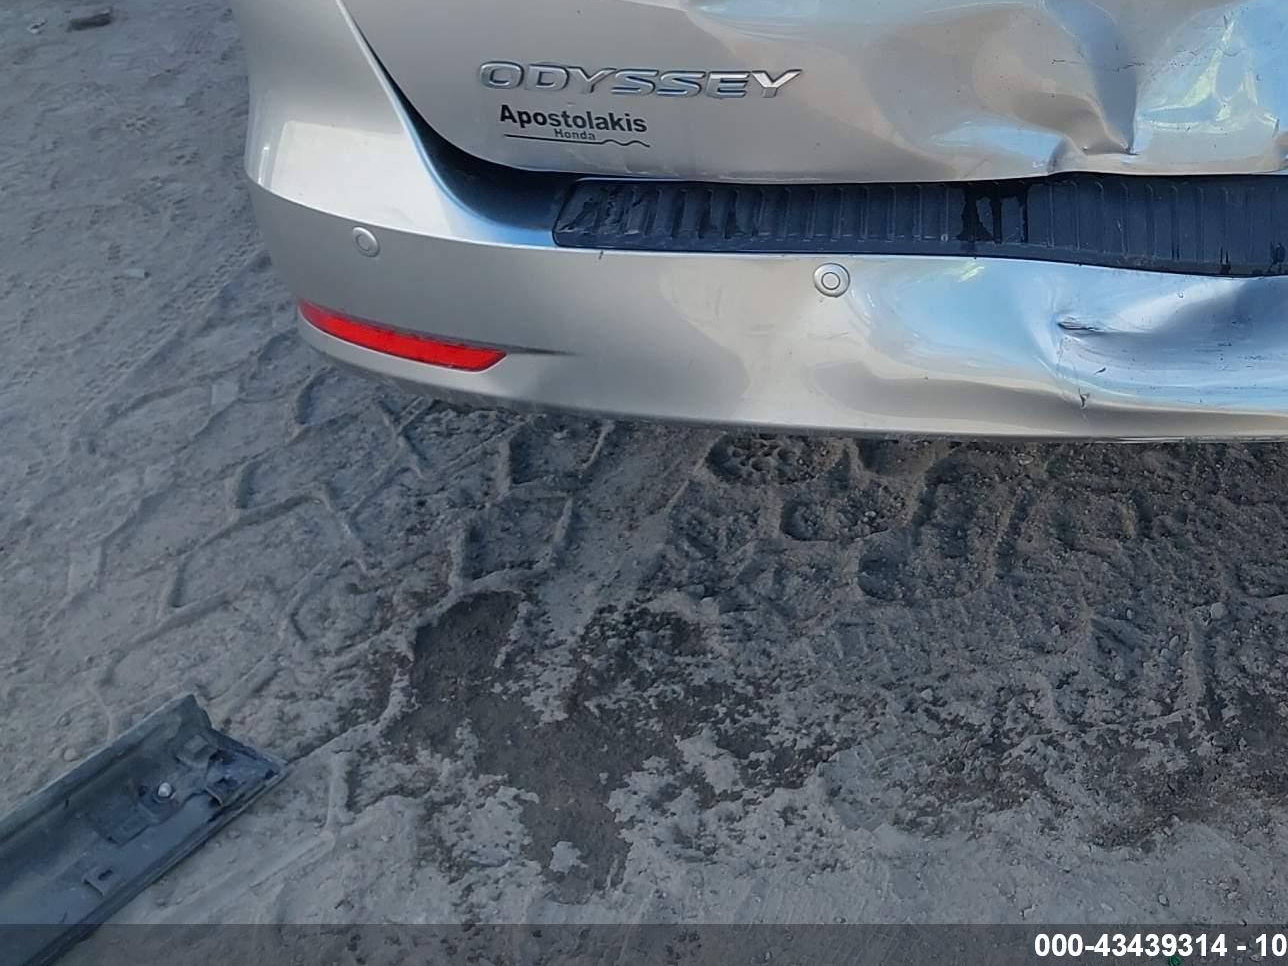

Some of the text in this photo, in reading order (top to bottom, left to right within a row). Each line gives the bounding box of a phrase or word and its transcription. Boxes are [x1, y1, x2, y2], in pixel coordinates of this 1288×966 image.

[479, 60, 802, 99] ODYSSEY
[500, 104, 648, 133] Apostolakis
[553, 128, 596, 141] Honda
